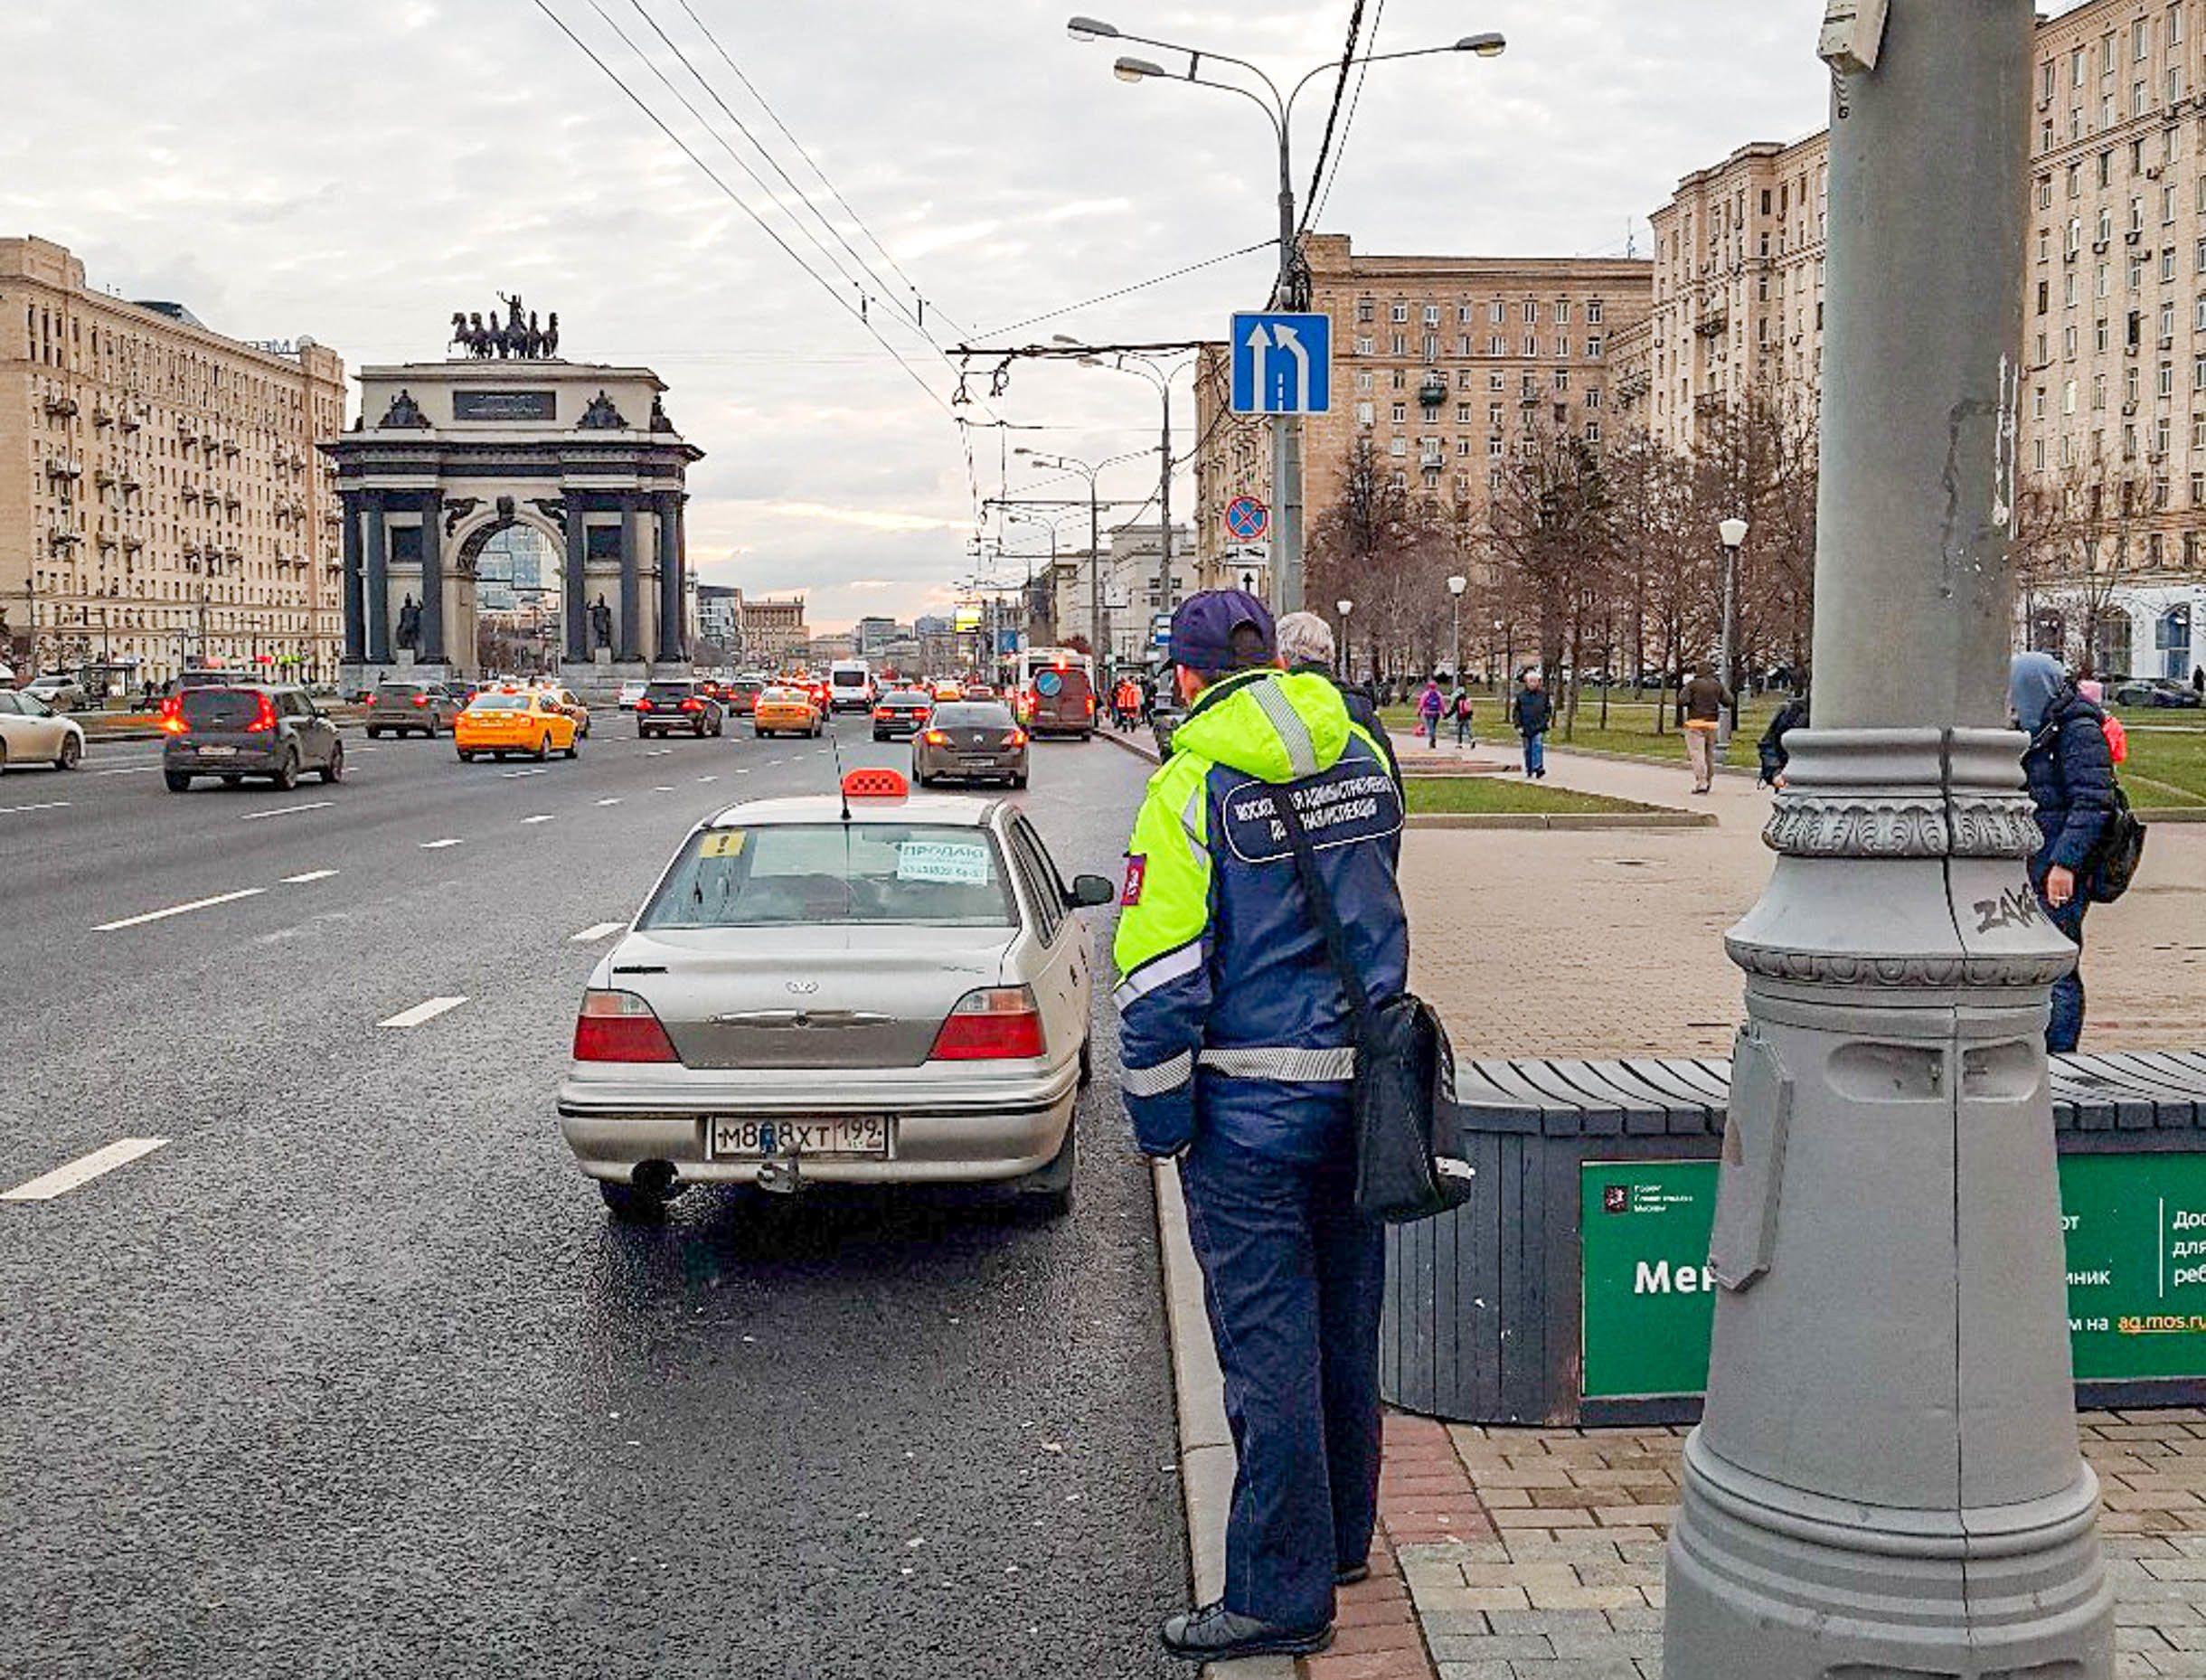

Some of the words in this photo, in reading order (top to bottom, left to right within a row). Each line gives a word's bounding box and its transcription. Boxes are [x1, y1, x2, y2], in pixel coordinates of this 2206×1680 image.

[837, 1119, 876, 1140] 199
[2173, 1241, 2206, 1259] для
[2087, 1317, 2109, 1331] на
